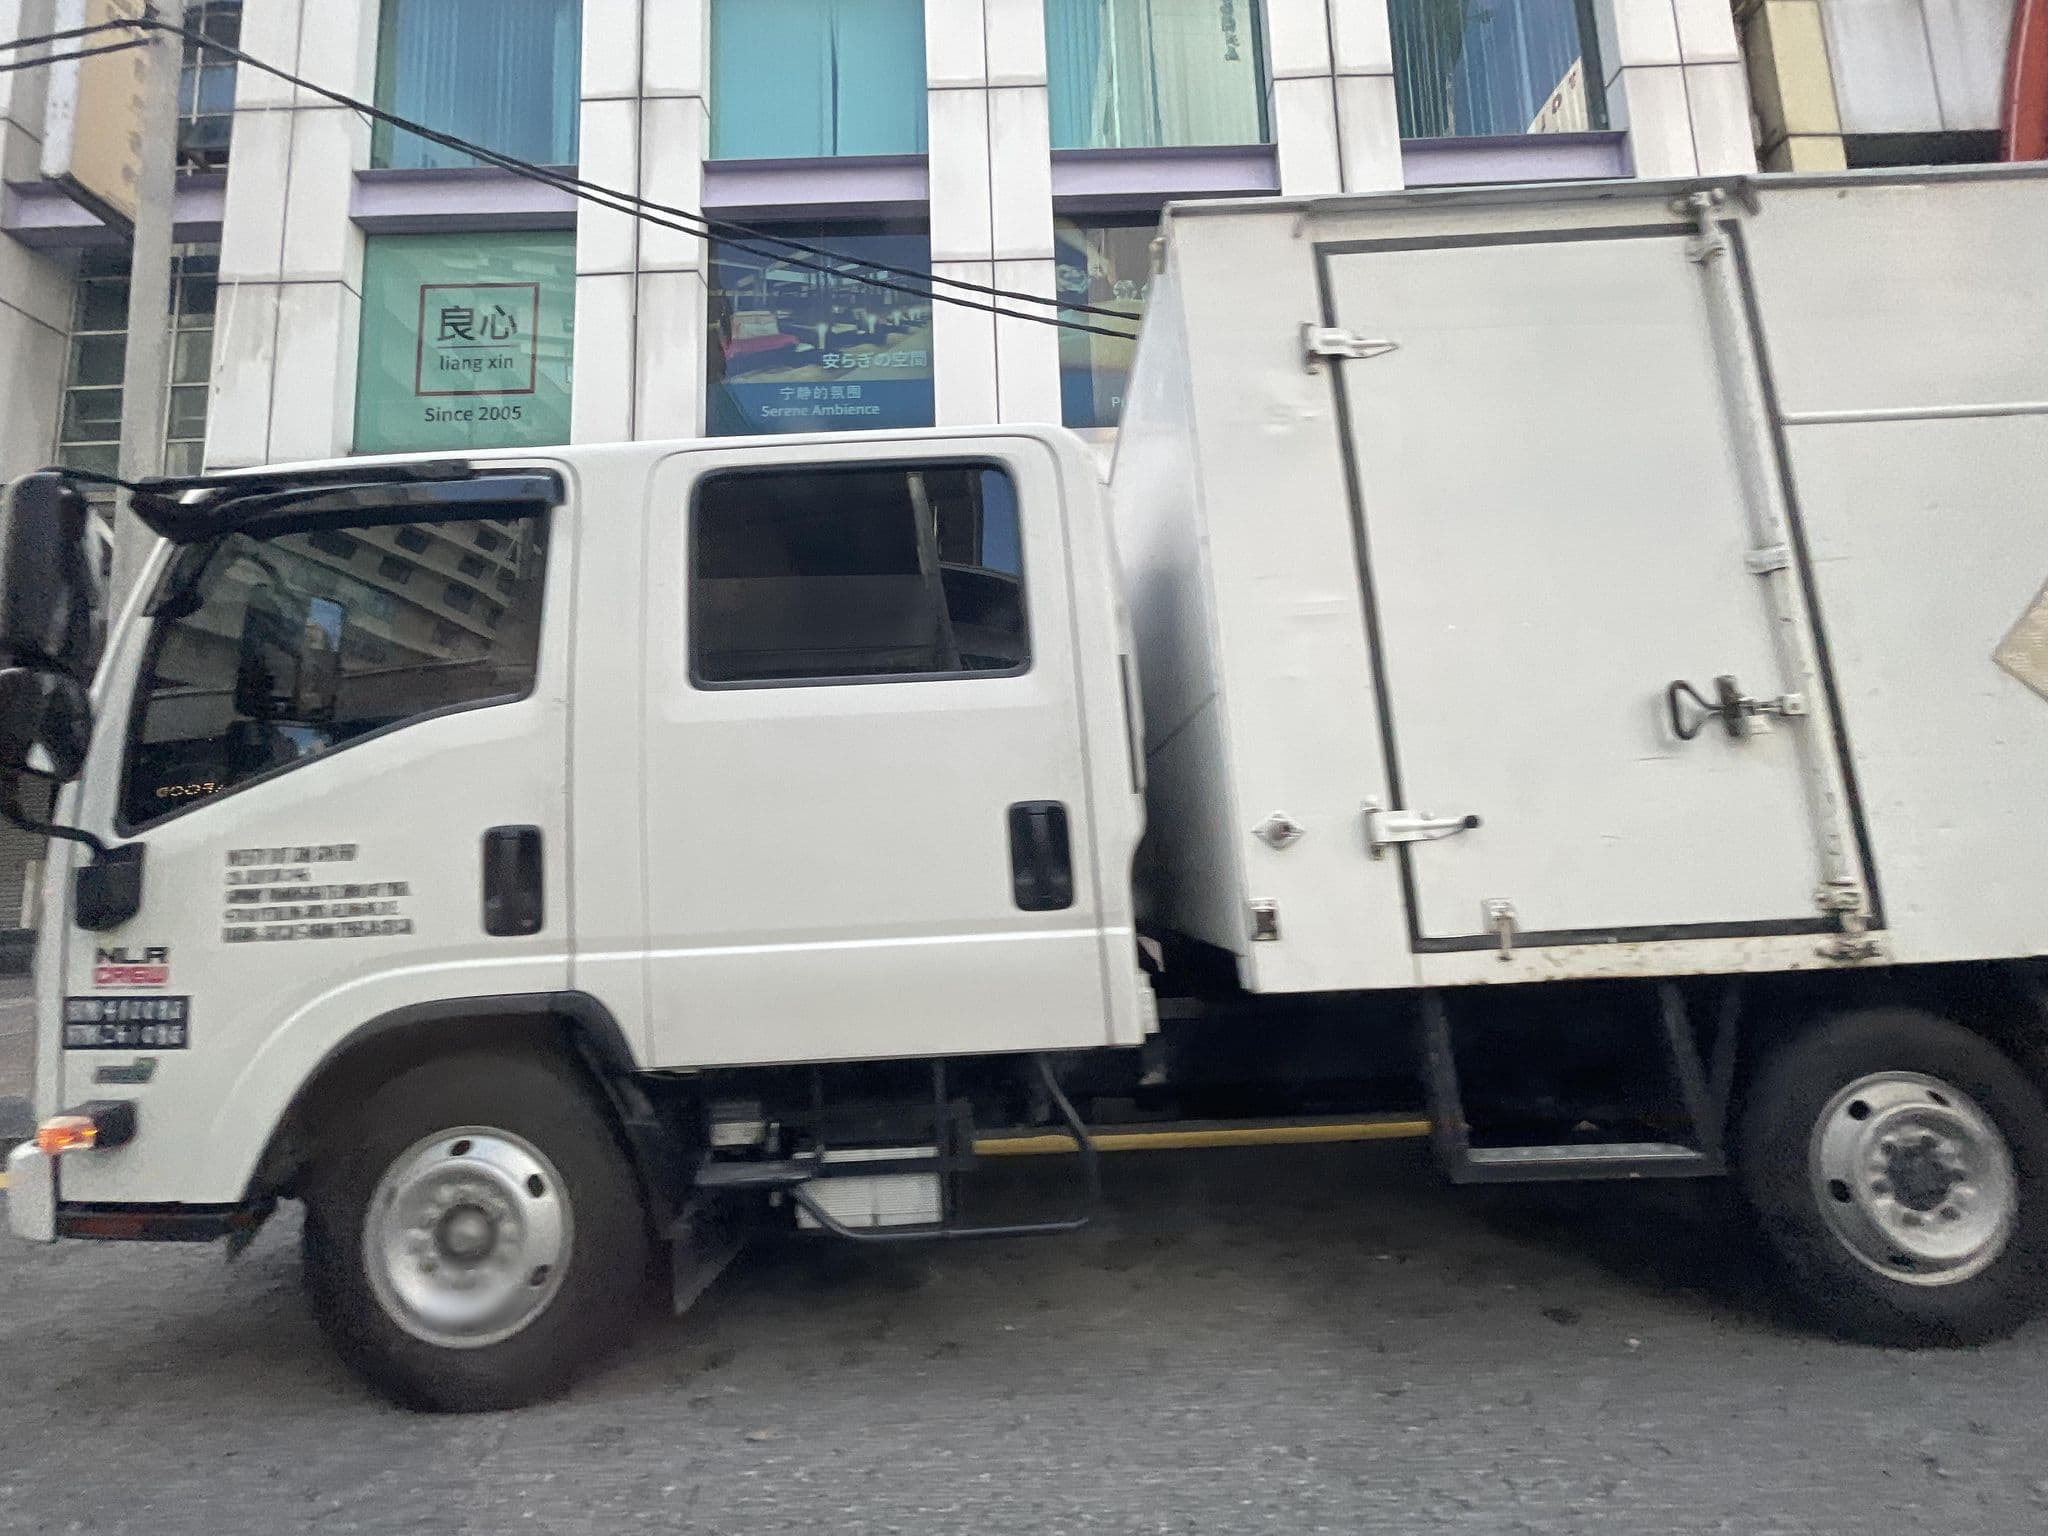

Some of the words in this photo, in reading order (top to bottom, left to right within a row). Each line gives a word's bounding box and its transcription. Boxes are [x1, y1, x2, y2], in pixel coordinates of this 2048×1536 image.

[436, 304, 518, 341] 良心
[439, 355, 483, 373] liang
[487, 354, 514, 369] xin
[822, 351, 928, 369] 安らぎの空間
[424, 406, 473, 422] Since
[478, 405, 522, 421] 2005
[761, 405, 809, 417] Serene
[812, 403, 880, 416] Ambience
